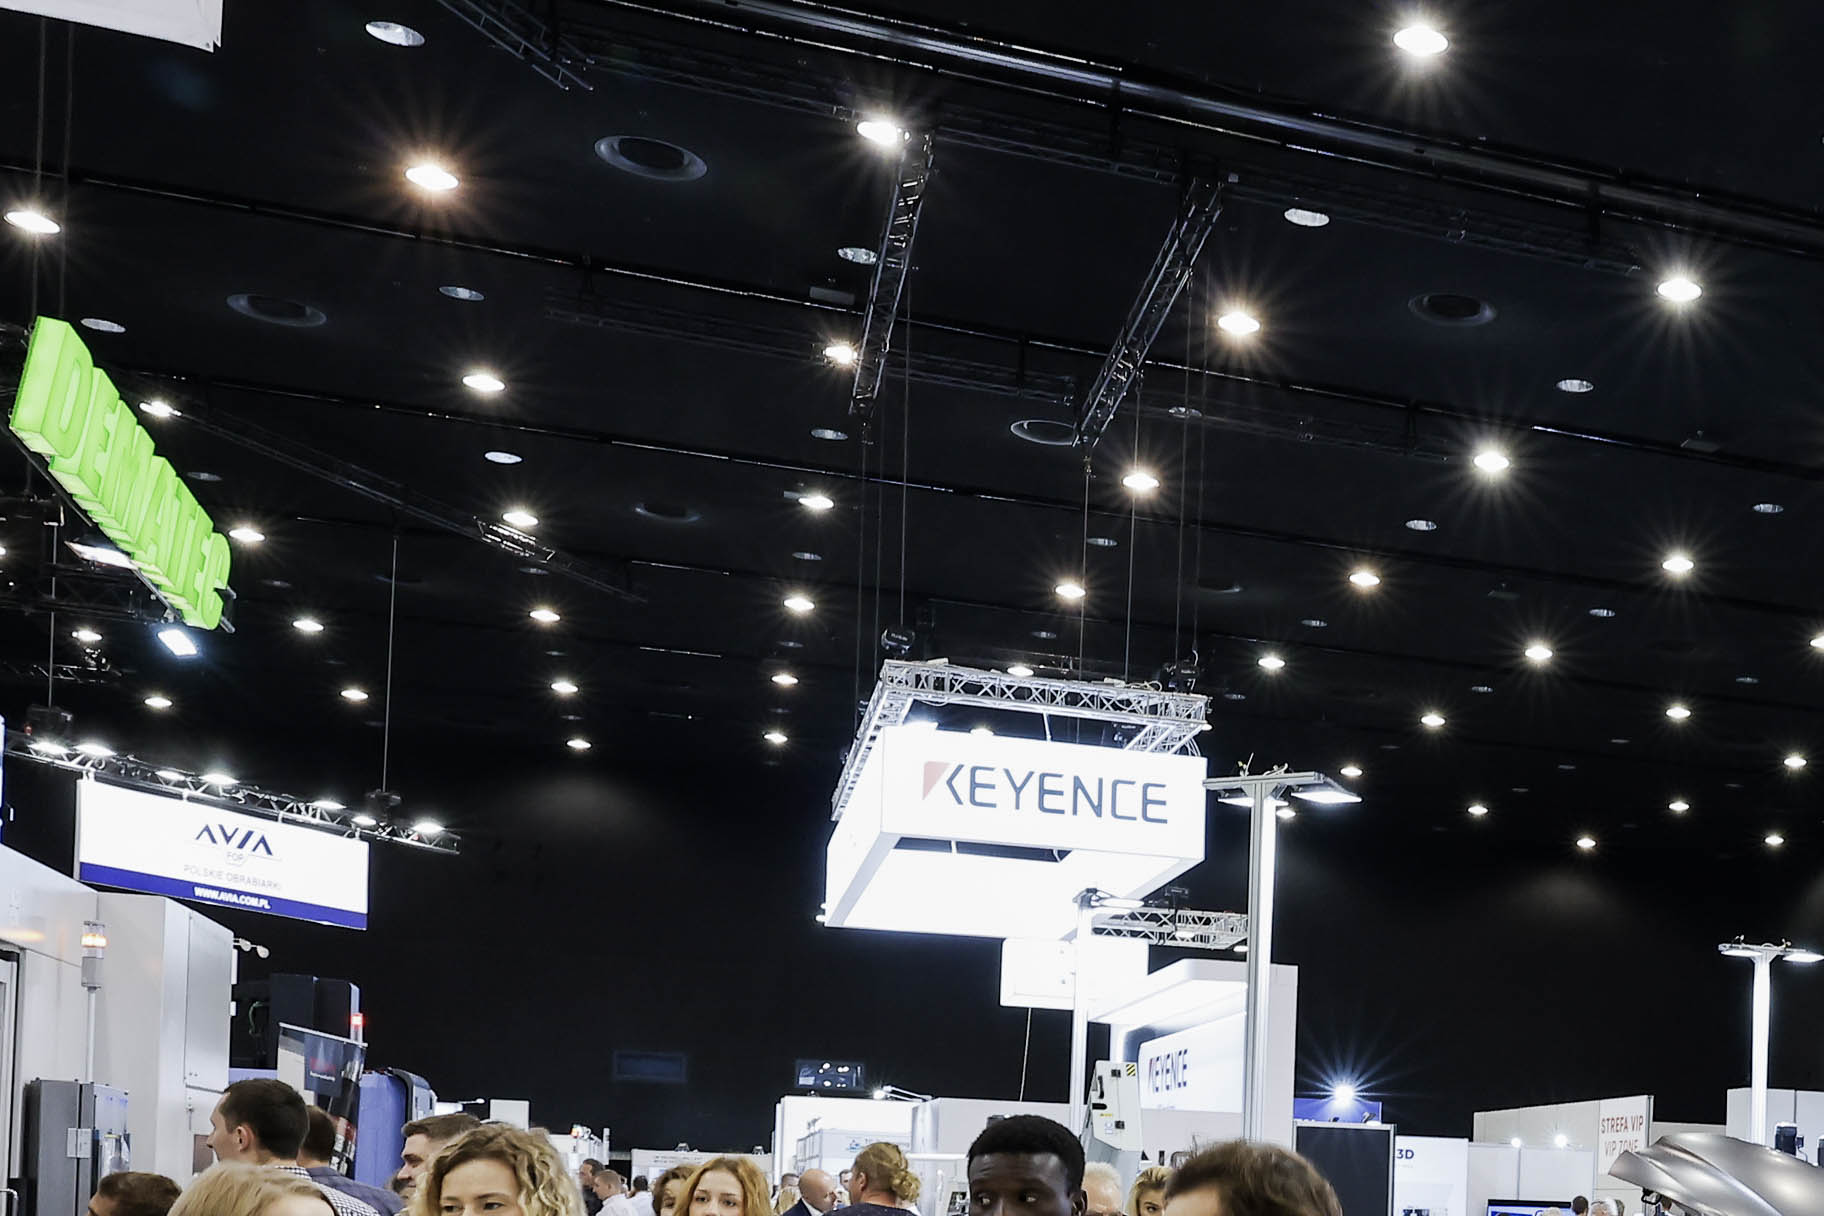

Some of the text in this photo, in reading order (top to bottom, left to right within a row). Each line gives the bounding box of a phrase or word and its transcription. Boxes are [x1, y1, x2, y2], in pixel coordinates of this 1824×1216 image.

[923, 761, 1168, 824] KEYENCE
[195, 824, 273, 856] AVIA
[1149, 1048, 1189, 1096] KEYENCE
[1601, 1115, 1644, 1135] STREFA VIP
[1396, 1149, 1414, 1160] 3D
